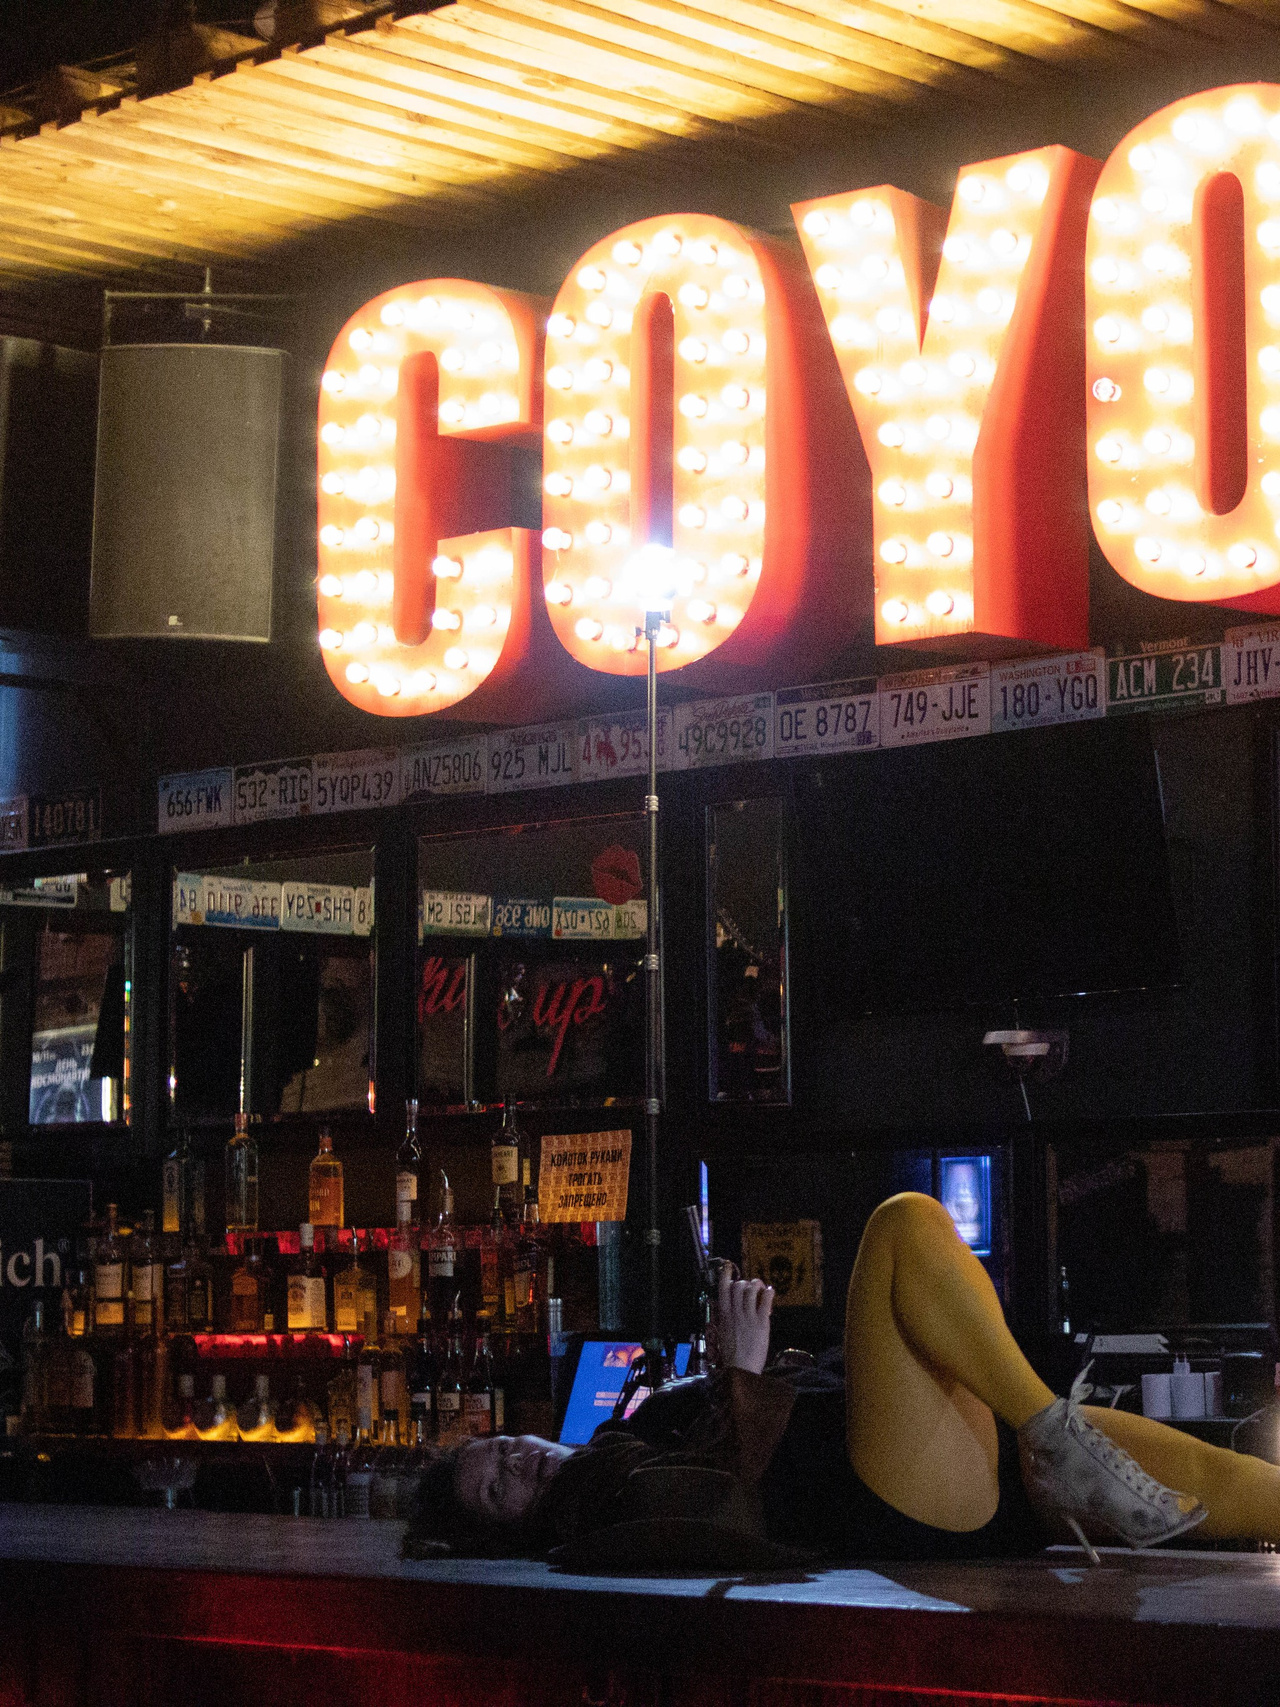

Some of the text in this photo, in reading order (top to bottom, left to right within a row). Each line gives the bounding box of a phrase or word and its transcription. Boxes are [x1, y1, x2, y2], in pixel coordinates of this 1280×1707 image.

[1140, 637, 1188, 653] Vermont
[999, 665, 1061, 682] WASHINGTON
[1116, 649, 1213, 699] ACM 234
[890, 683, 979, 729] 749-JJE
[816, 700, 871, 737] 8787
[491, 743, 572, 781] 925 MJL
[550, 1148, 623, 1168] КОЙОТОК РУКАМИ
[568, 1171, 603, 1187] ТРОГАТЬ
[558, 1190, 608, 1209] ЗАПРЕЩЕНО
